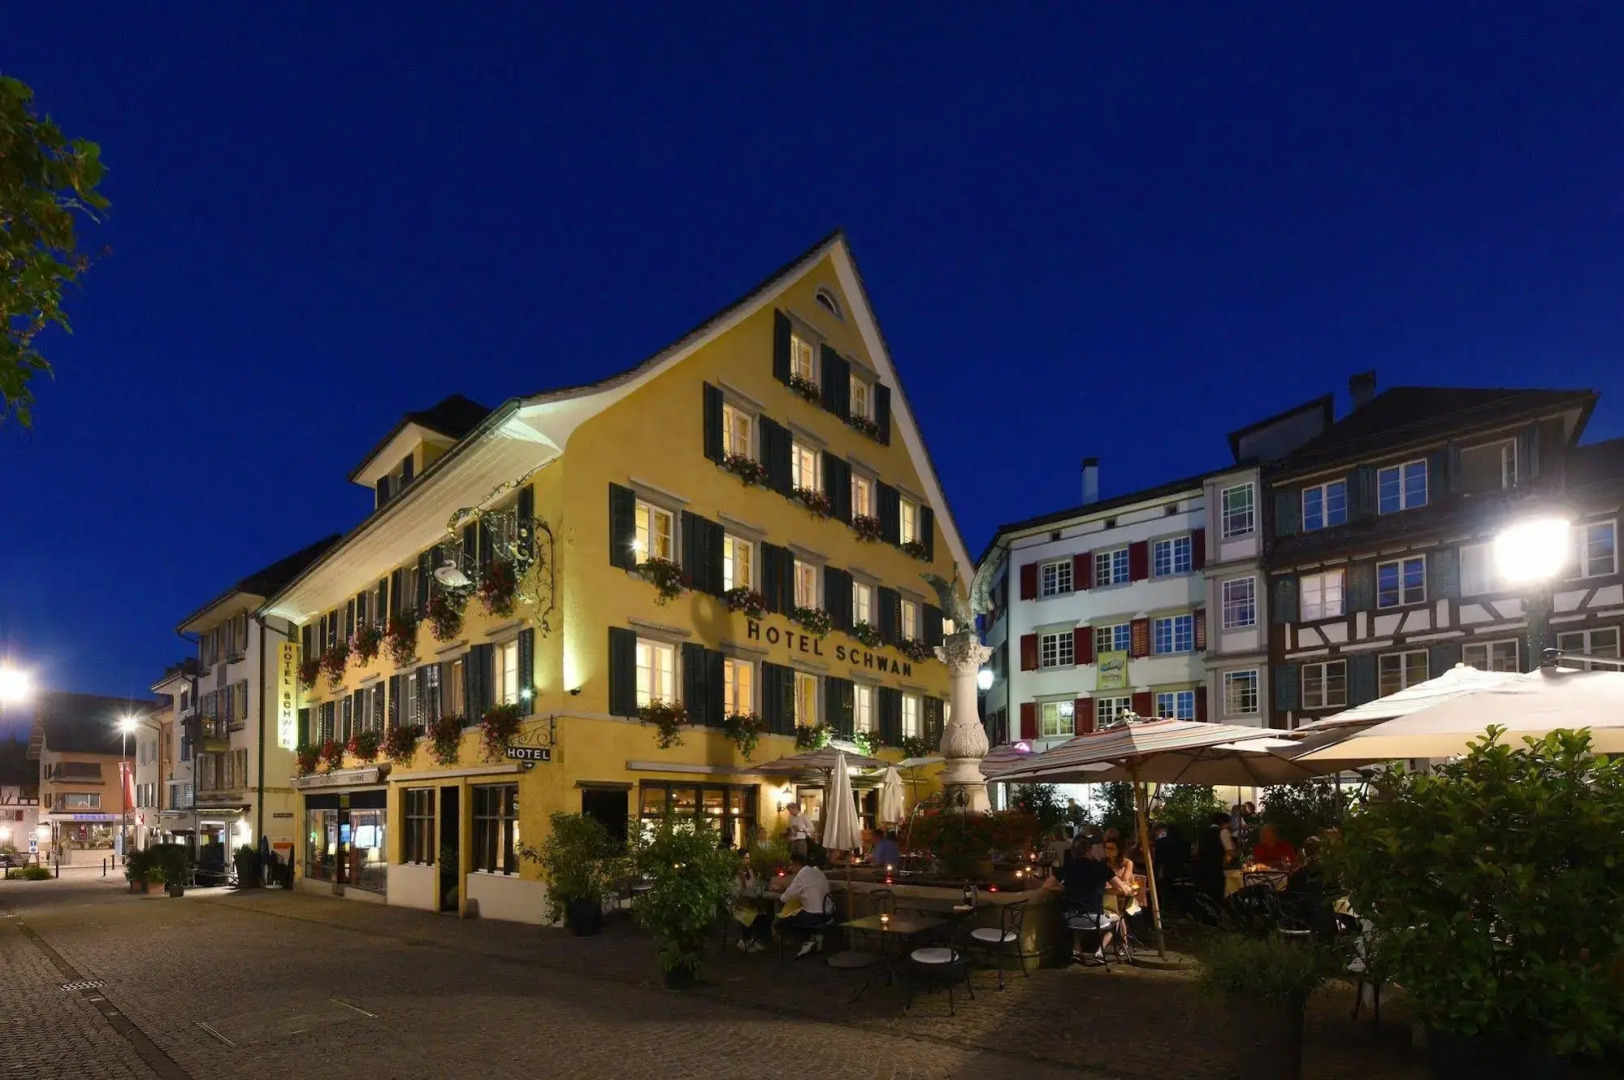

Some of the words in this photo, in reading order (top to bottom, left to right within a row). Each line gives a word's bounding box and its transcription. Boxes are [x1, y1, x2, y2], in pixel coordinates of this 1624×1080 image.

[284, 644, 293, 685] HOTEL
[747, 622, 824, 656] HOTEL
[836, 645, 912, 677] SCHWAN
[282, 691, 292, 745] SCHWAN
[507, 748, 549, 760] HOTEL
